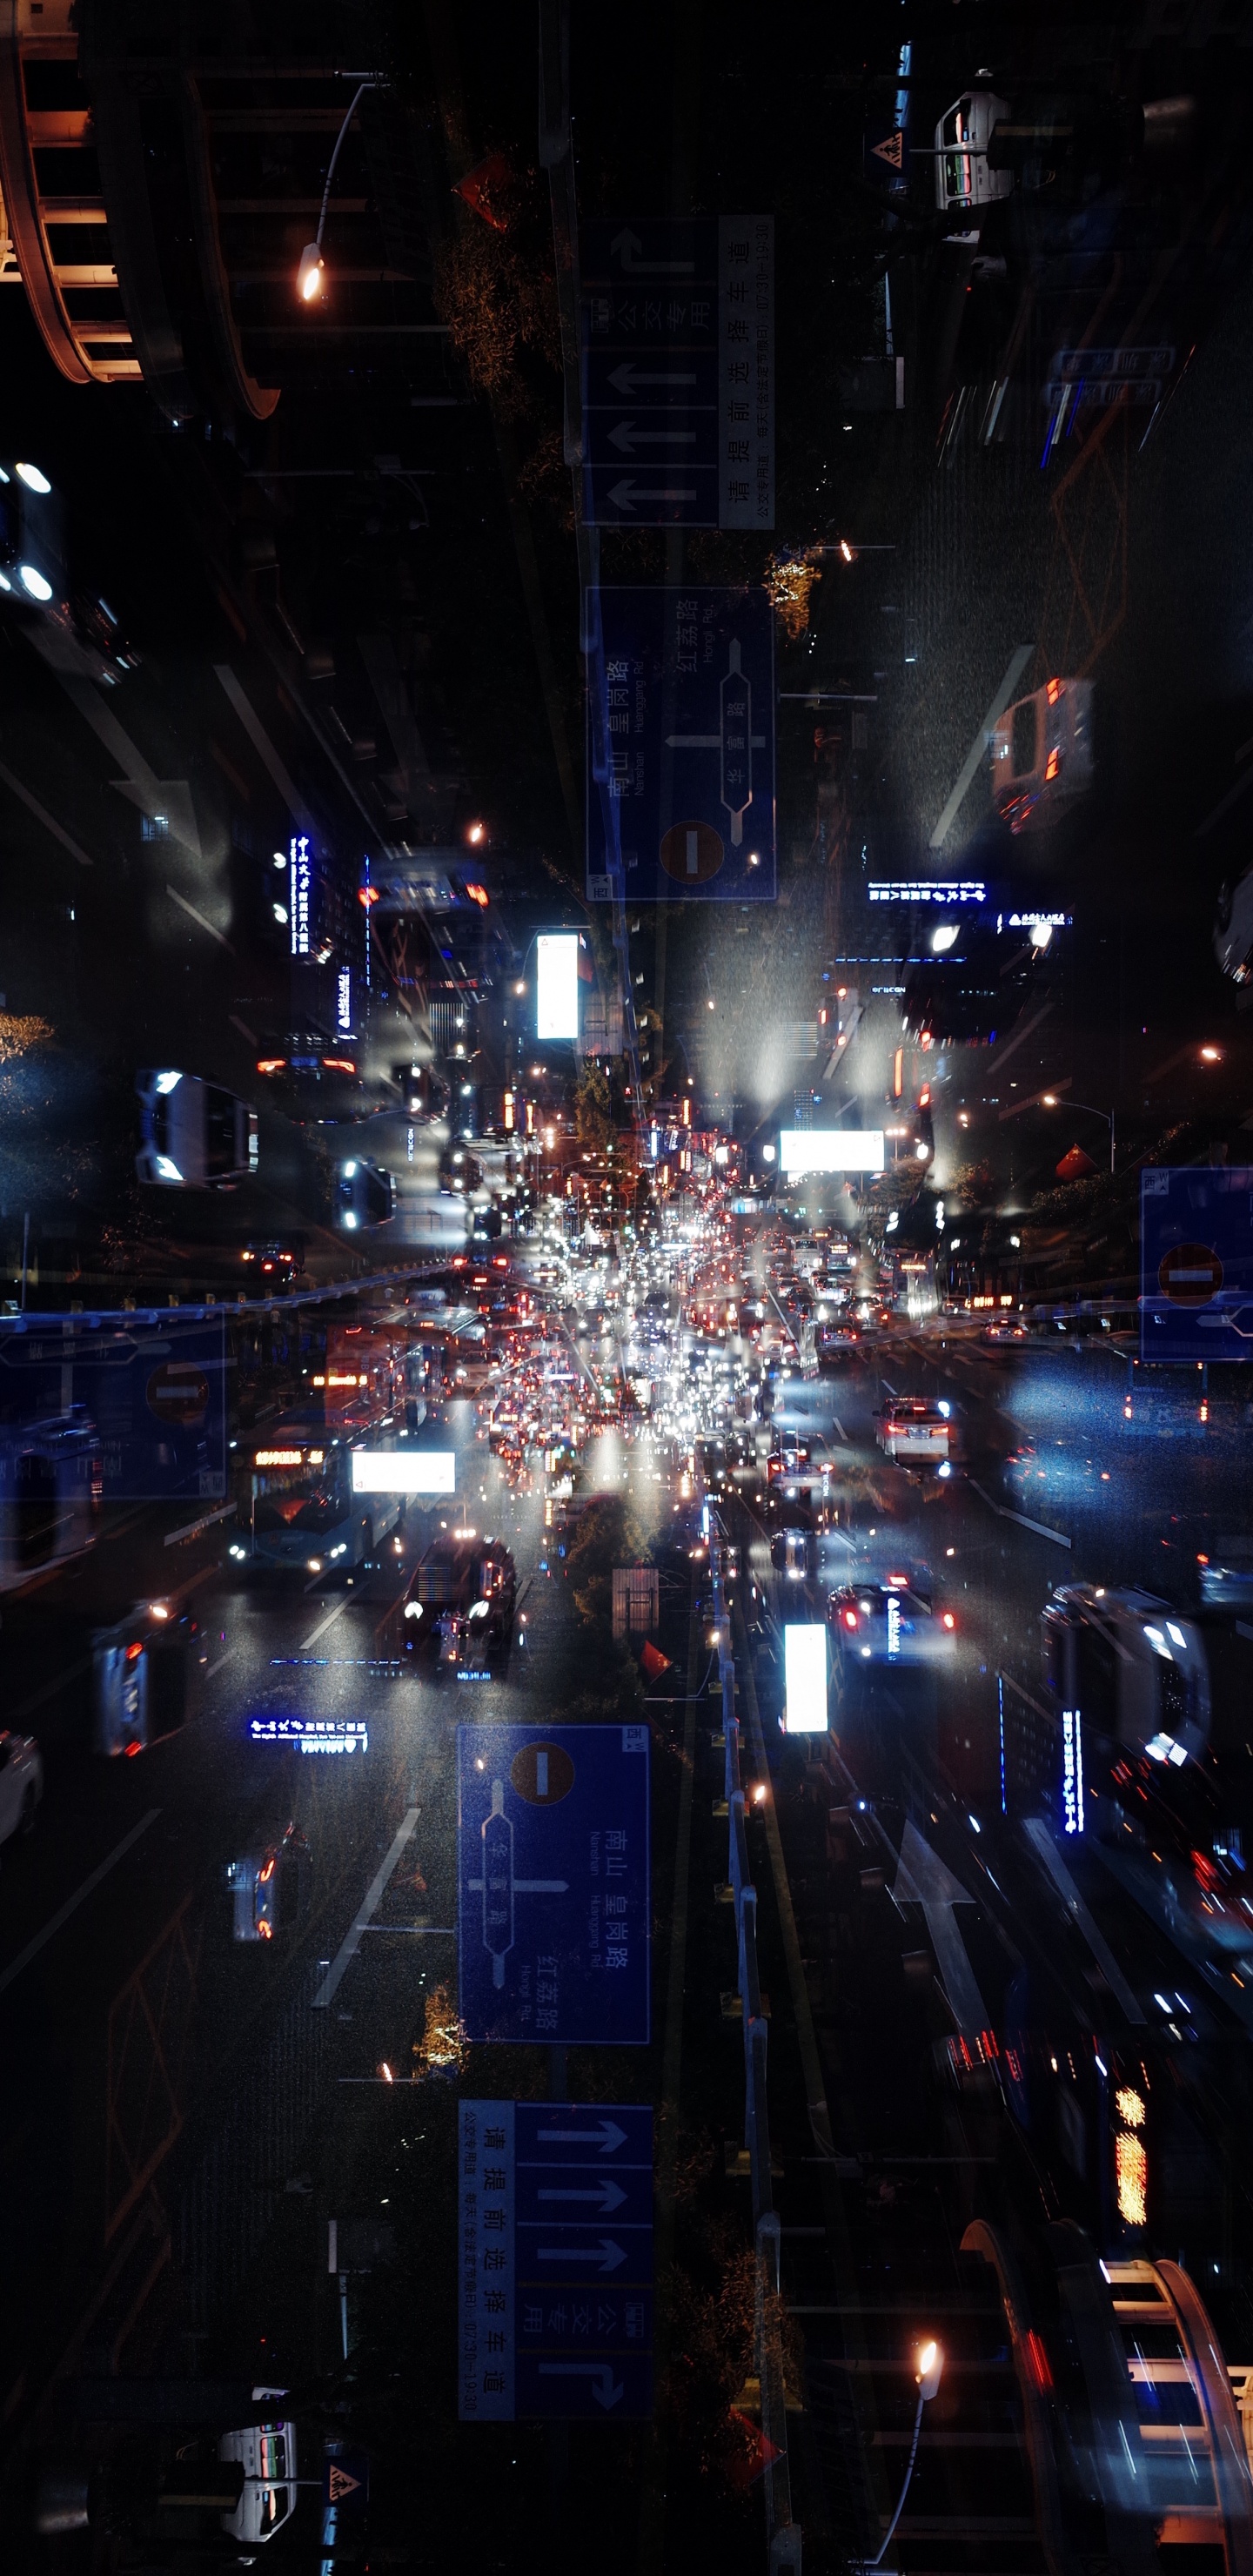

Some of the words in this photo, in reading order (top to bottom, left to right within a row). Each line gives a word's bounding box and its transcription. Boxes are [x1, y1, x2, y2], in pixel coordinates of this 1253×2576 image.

[727, 241, 750, 503] 请提前选择车道
[675, 600, 700, 673] 红荔路
[703, 631, 715, 663] Hongli
[634, 661, 645, 674] Rd
[606, 660, 630, 734] 皇岗路
[634, 681, 647, 733] Huanggang
[727, 701, 746, 783] 华富路
[607, 752, 630, 797] 南山
[634, 752, 645, 796] Nanshan
[591, 875, 600, 884] W
[593, 888, 608, 898] 西
[1144, 1176, 1156, 1190] 西
[1159, 1172, 1168, 1183] W
[591, 1831, 600, 1875] Nanshan
[605, 1830, 627, 1875] 南山
[588, 1895, 600, 1948] Huanggang
[605, 1895, 627, 1969] 皇岗路
[519, 1965, 532, 1997] Hongli
[591, 1954, 600, 1968] Rd
[535, 1955, 559, 2029] 红荔路
[483, 2127, 506, 2393] 请提前选择车道
[522, 2303, 618, 2336] 公交专用
